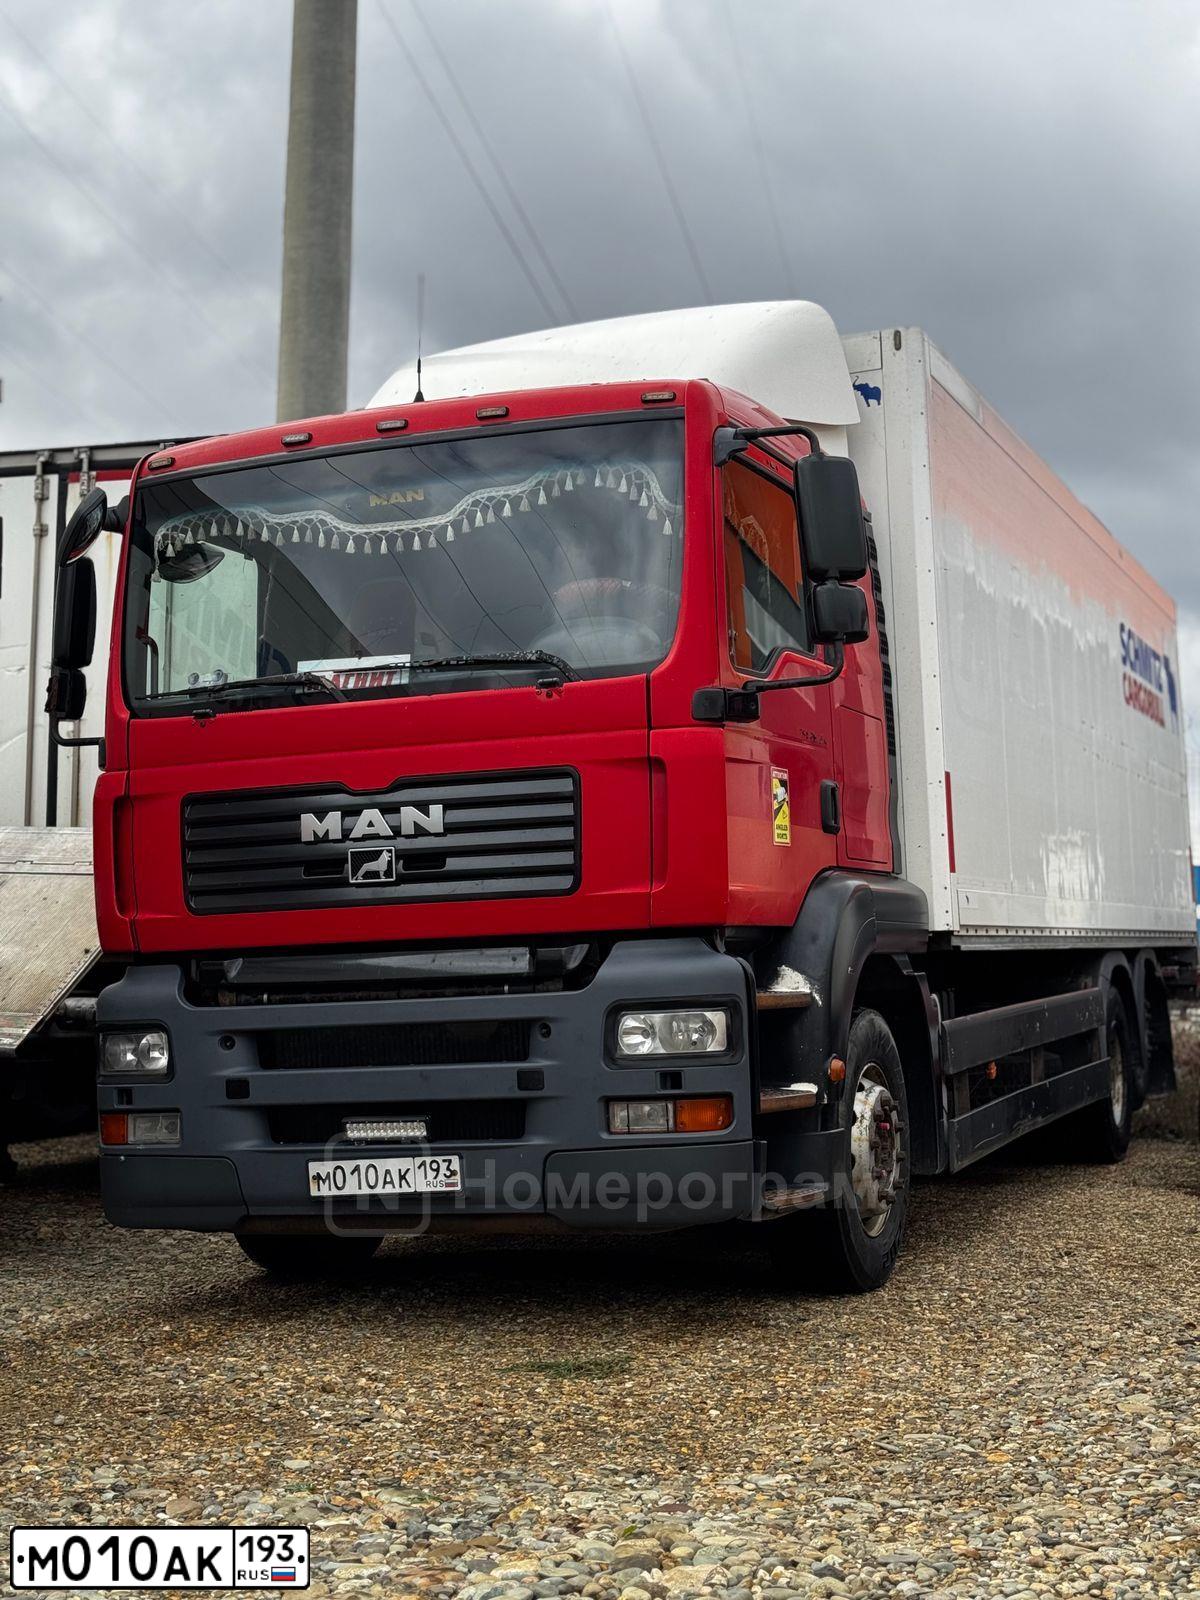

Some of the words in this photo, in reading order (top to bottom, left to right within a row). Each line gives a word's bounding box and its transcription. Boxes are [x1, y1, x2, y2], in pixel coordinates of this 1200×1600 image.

[369, 488, 425, 507] MAN
[301, 804, 445, 842] MAN
[417, 1158, 454, 1180] 193
[425, 1180, 445, 1188] RUS
